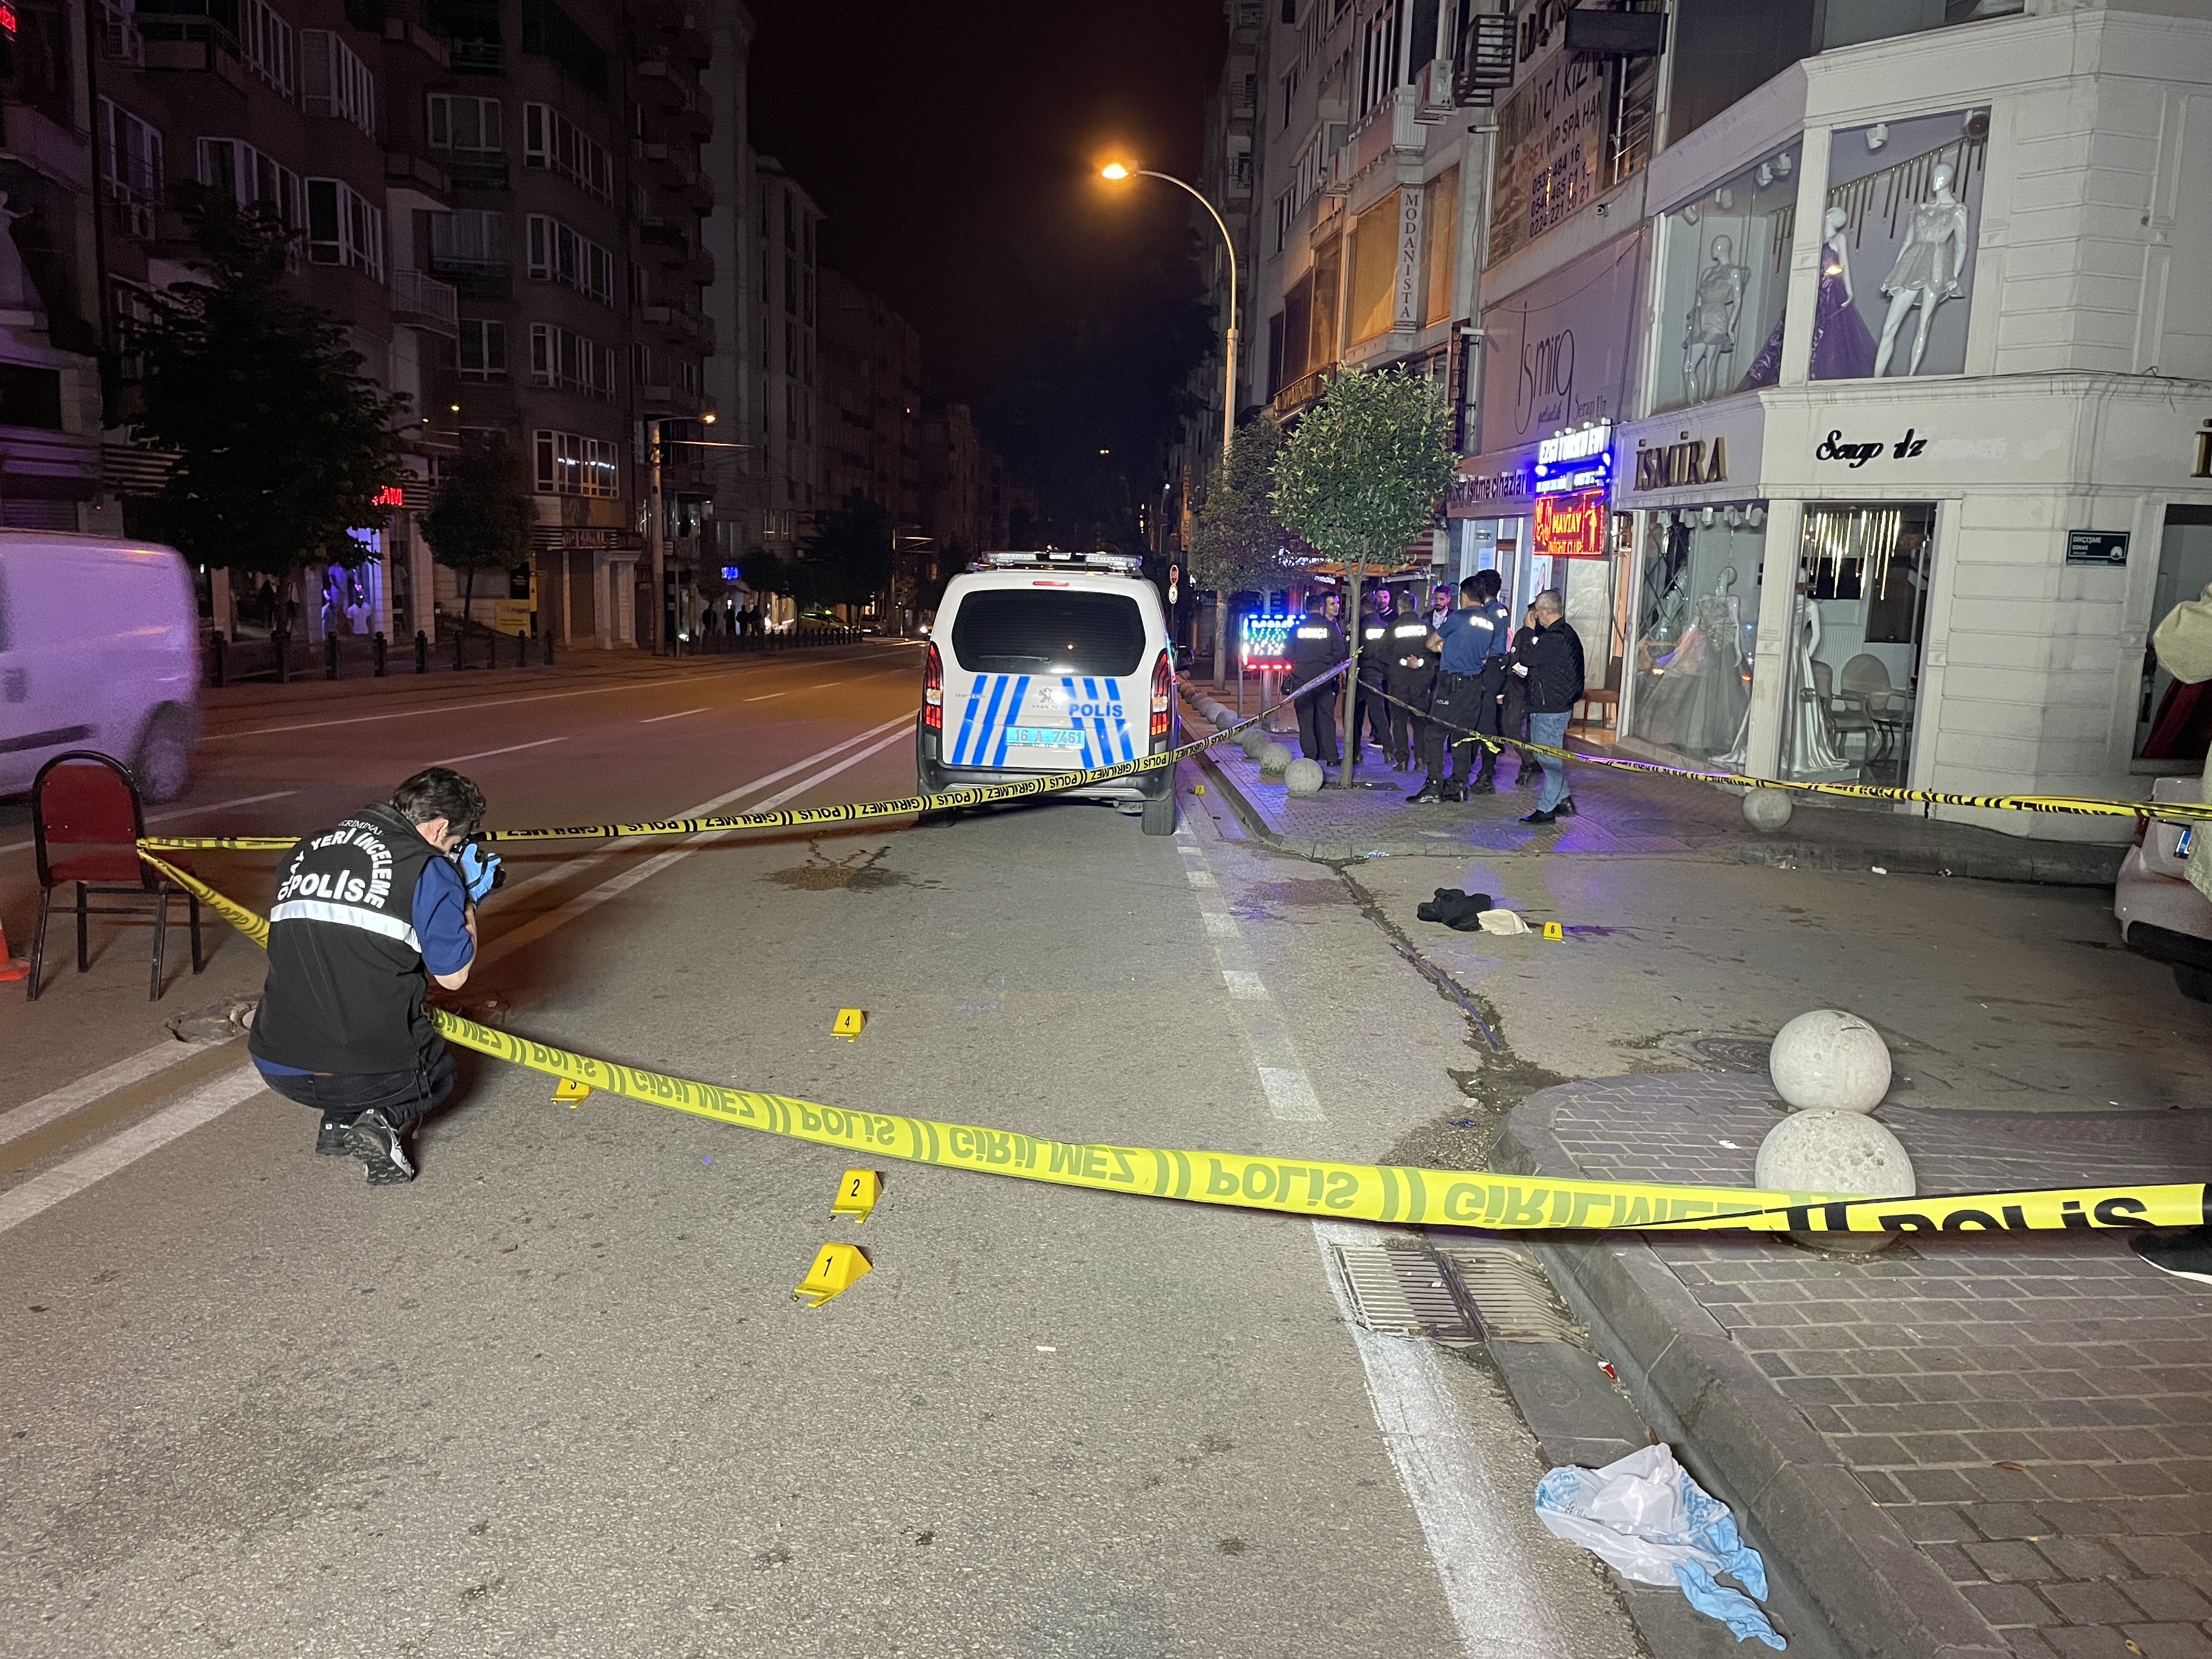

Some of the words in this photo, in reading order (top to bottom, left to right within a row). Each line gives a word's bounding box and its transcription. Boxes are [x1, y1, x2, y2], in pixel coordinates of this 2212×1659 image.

[1552, 153, 1567, 178] 484
[1571, 143, 1580, 165] 16
[1549, 200, 1564, 224] 221
[1579, 181, 1590, 205] 21
[1400, 193, 1419, 318] MODANISTA
[1633, 431, 1728, 492] İSMİRA
[1069, 702, 1123, 718] POLİS
[1015, 729, 1028, 742] 16
[1035, 730, 1042, 742] A
[1052, 730, 1081, 743] 7461
[705, 810, 778, 827] GİRİLMEZ
[798, 807, 842, 820] POLİS
[858, 797, 921, 815] GİRİLMEZ
[937, 791, 971, 806] POLİS
[988, 782, 1036, 799] GİRİLMEZ
[1049, 773, 1077, 788] POLİS
[1090, 763, 1132, 781] GİRİLMEZ
[286, 870, 366, 902] POLİS
[1550, 925, 1555, 934] 6
[844, 1015, 850, 1028] 4
[850, 1178, 860, 1197] 2
[823, 1256, 833, 1277] 1
